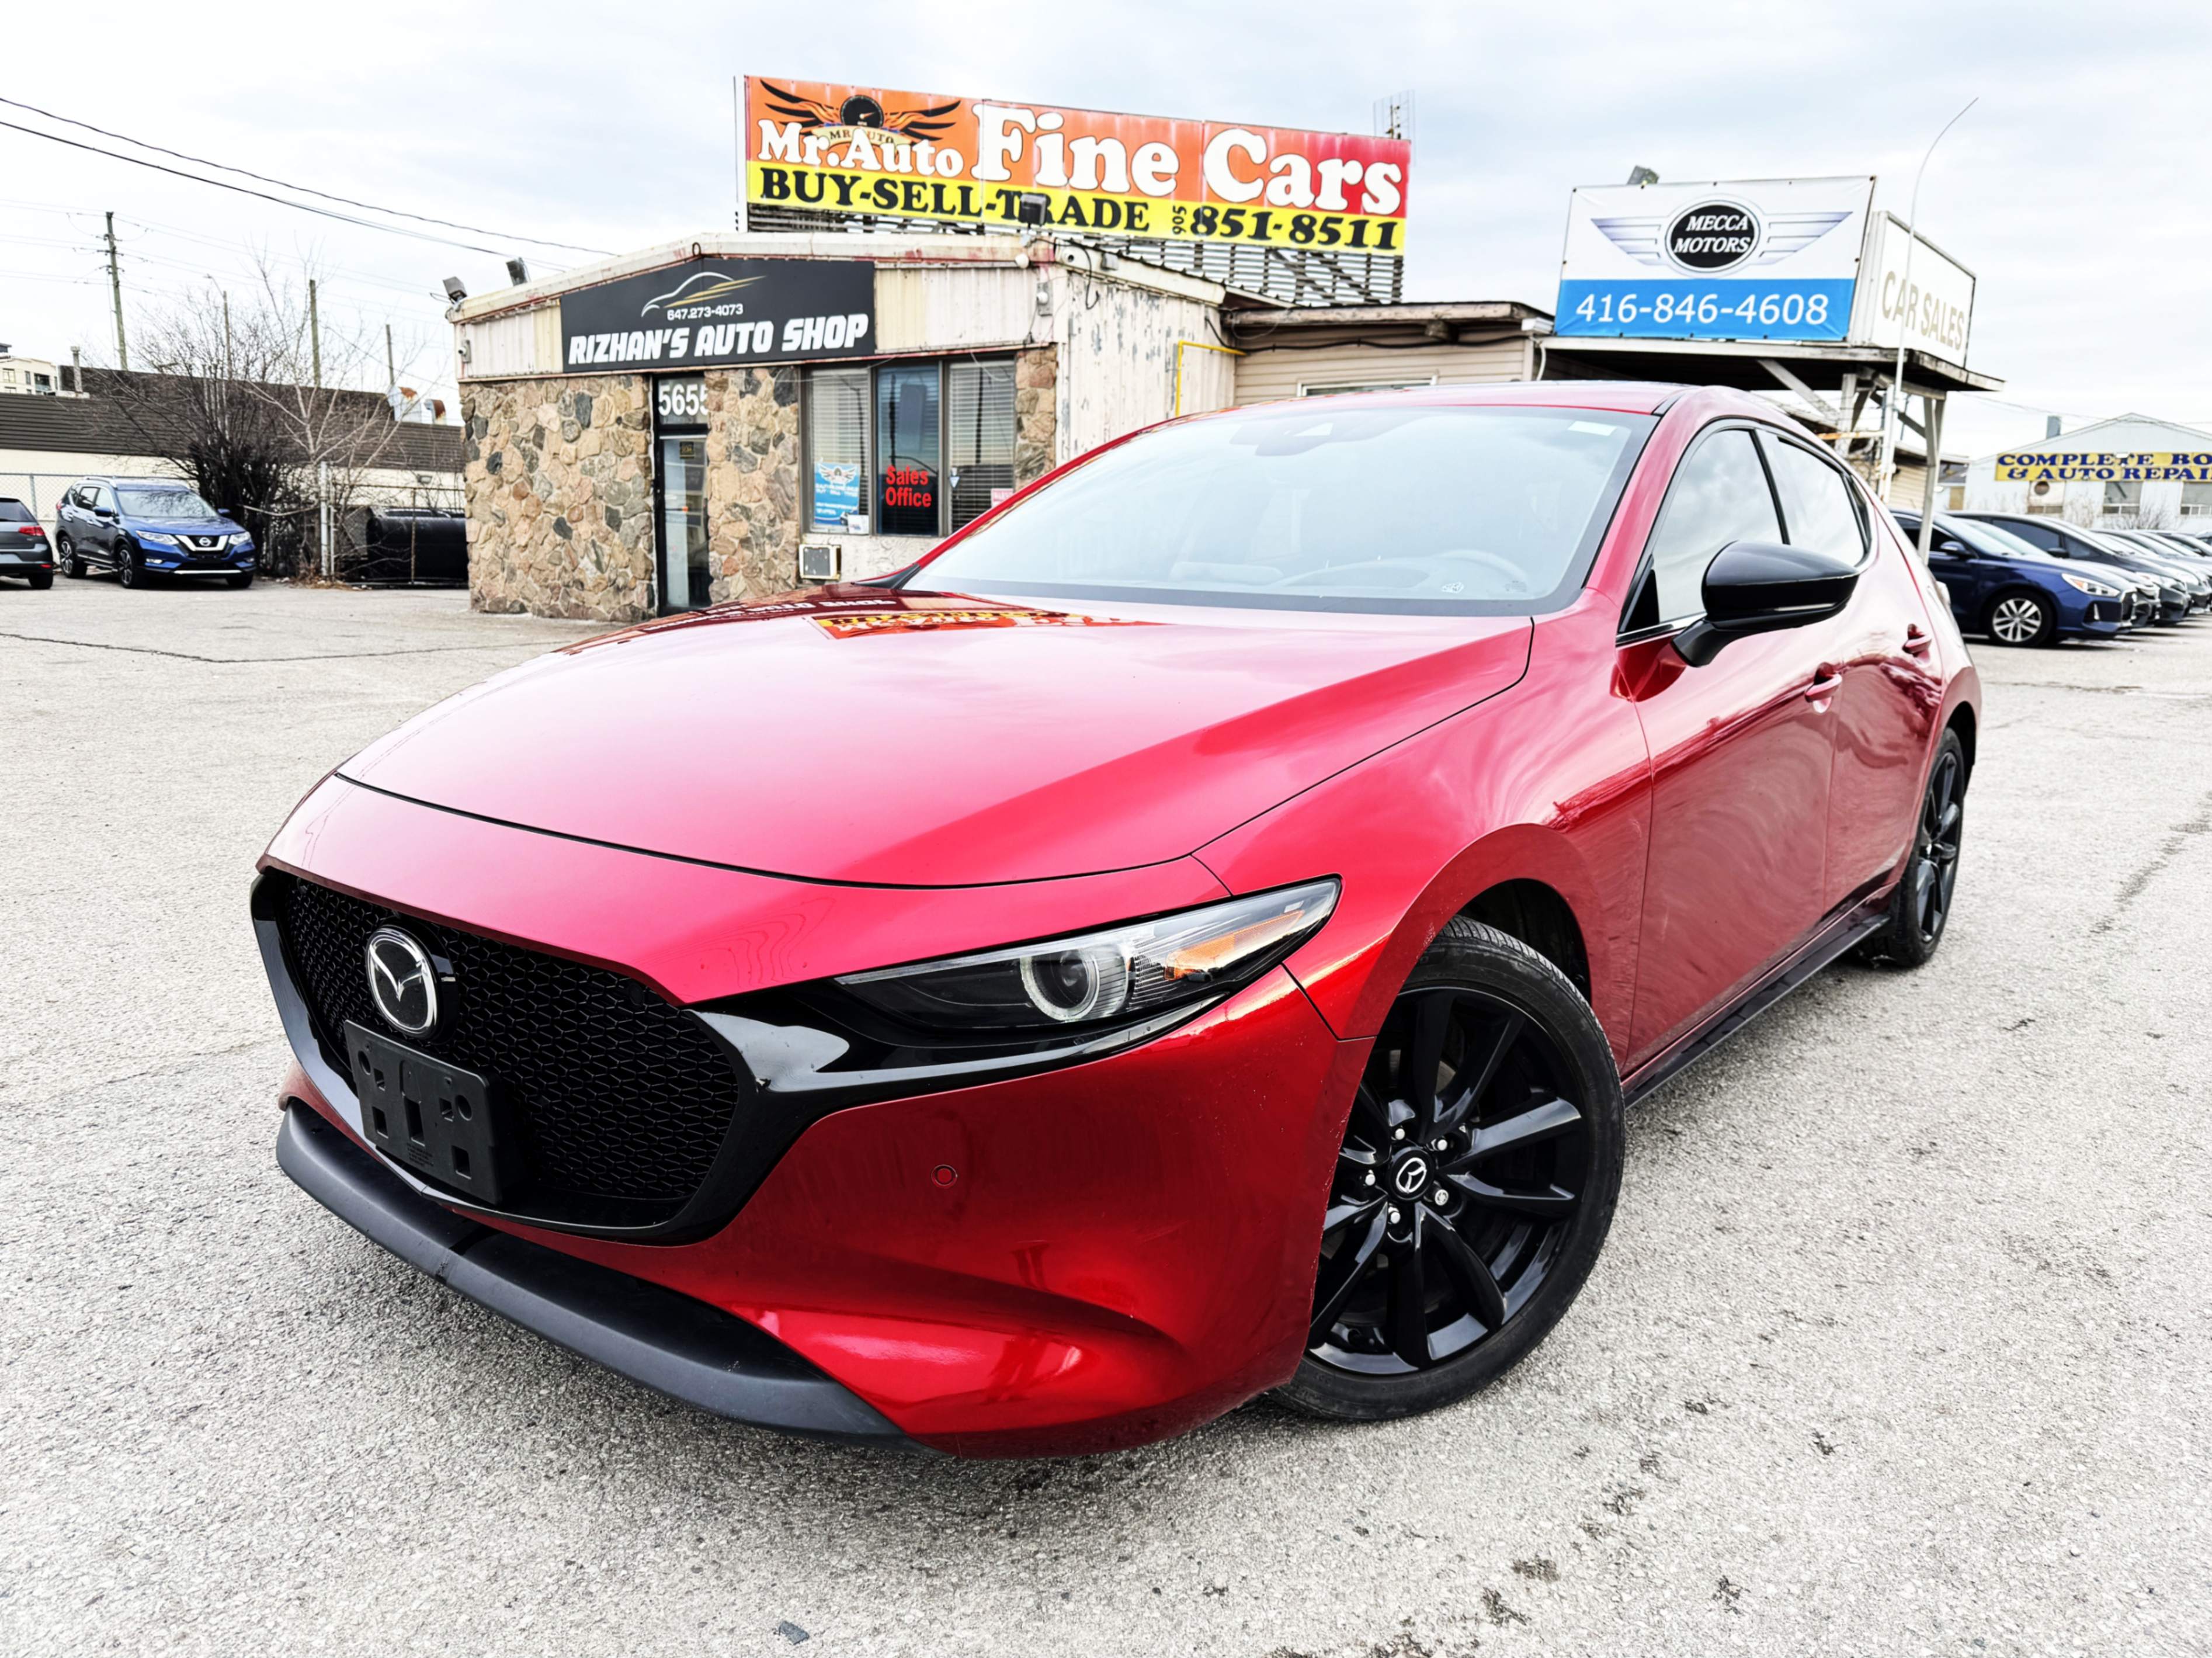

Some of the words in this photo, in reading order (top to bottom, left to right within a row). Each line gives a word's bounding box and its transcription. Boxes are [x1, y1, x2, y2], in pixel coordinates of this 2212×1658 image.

[758, 117, 964, 178] Mr.Auto
[972, 102, 1179, 196] Fine
[1204, 128, 1402, 215] Cars
[1172, 205, 1187, 235] 905
[1190, 205, 1397, 250] 851-8511
[1686, 215, 1748, 231] MECCA
[1673, 237, 1751, 253] MOTORS
[667, 303, 743, 321] 647.273-4073
[1576, 293, 1829, 325] 416-846-4608
[1882, 270, 1919, 331] CAR
[1921, 292, 1964, 351] SALES
[568, 327, 689, 364] RIZHAN'S
[694, 321, 773, 356] AUTO
[782, 313, 869, 351] SHOP
[886, 465, 928, 485] Sales
[2008, 468, 2028, 479] &
[2036, 468, 2114, 479] AUTO
[2123, 468, 2212, 480] REPAI
[885, 487, 932, 507] Office
